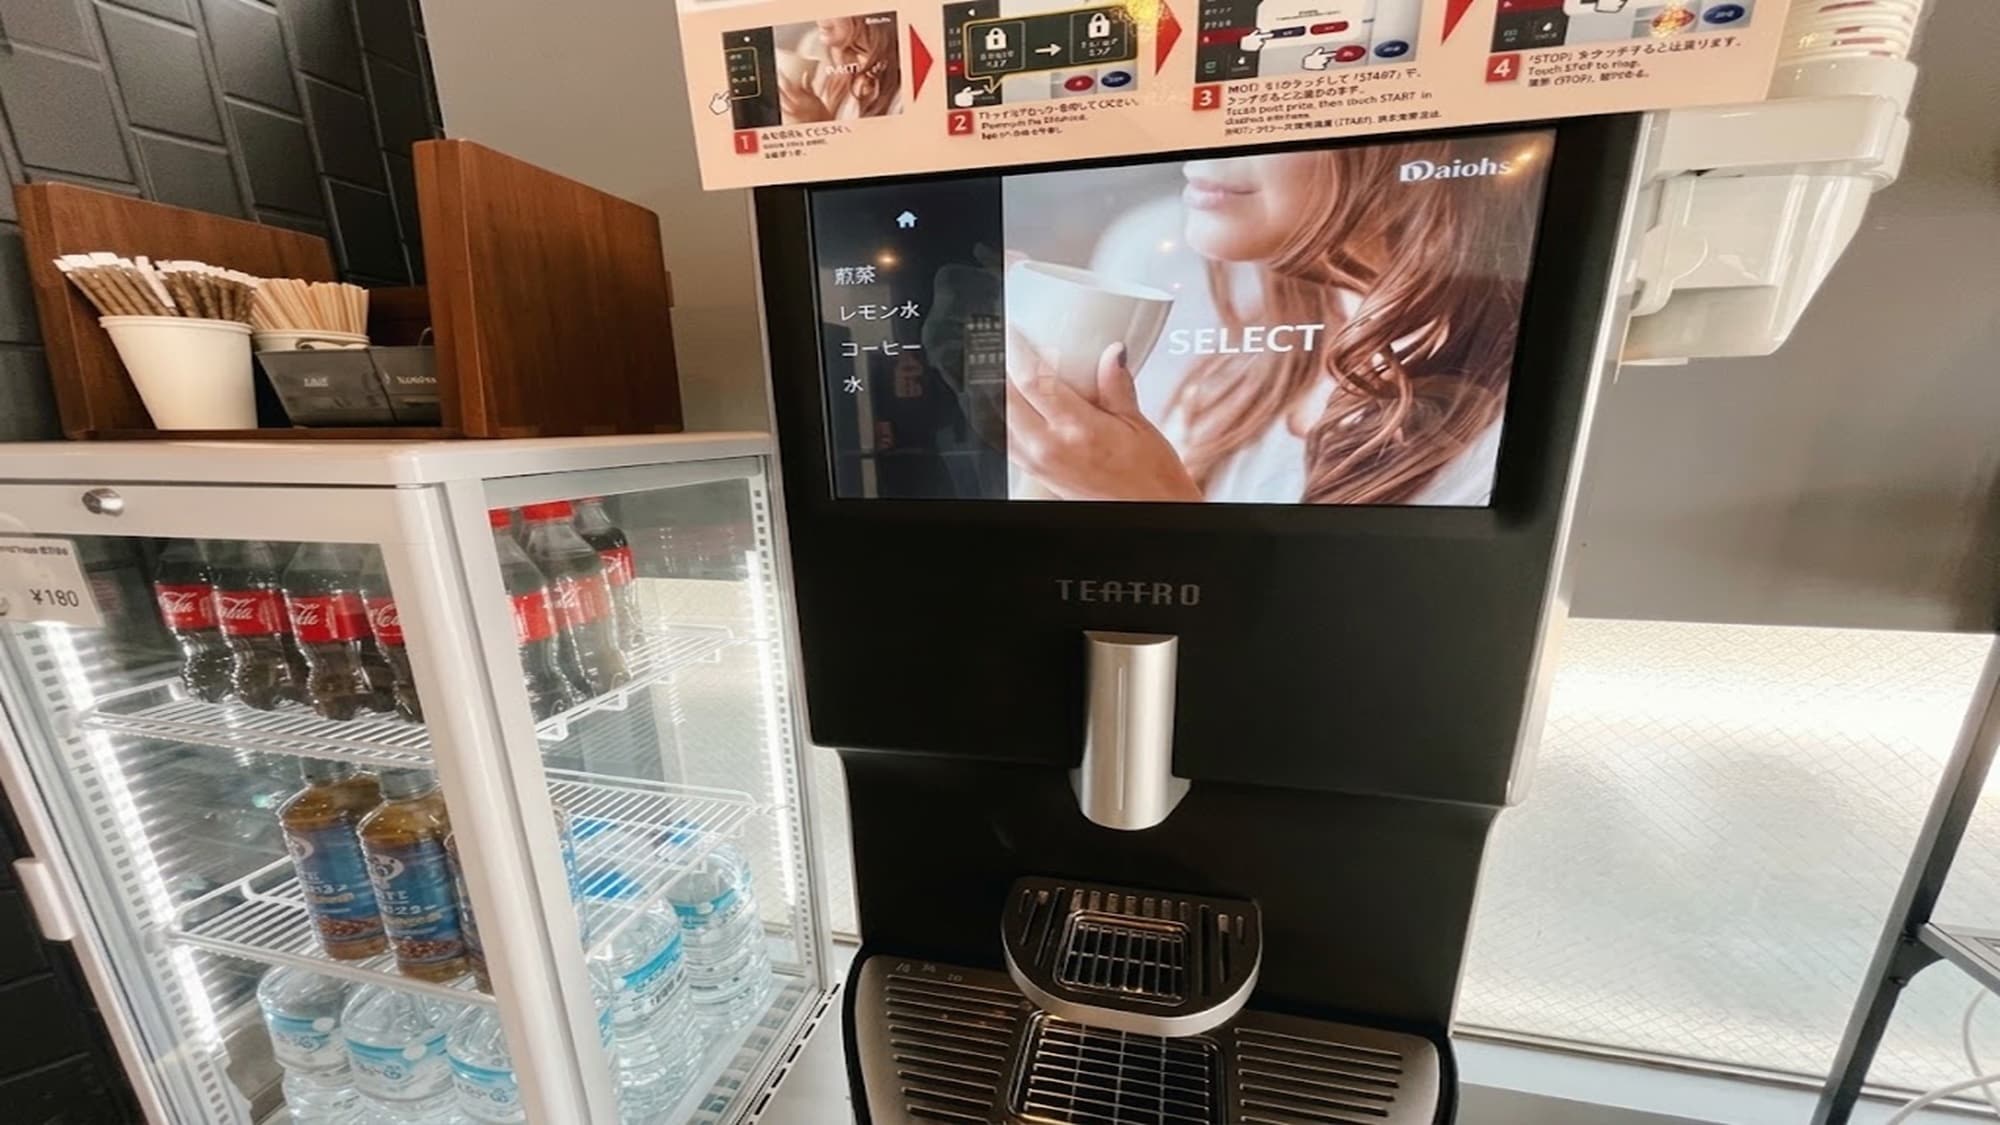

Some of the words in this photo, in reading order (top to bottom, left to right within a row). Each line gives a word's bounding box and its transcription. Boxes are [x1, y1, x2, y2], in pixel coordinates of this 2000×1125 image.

[1493, 58, 1512, 77] 4
[1200, 89, 1213, 106] 3
[954, 115, 968, 132] 2
[740, 135, 750, 150] 1
[1400, 157, 1512, 182] Daiohs
[834, 265, 877, 285] 煎茶
[840, 300, 921, 321] レモン水
[841, 341, 922, 357] コーヒー
[1168, 324, 1325, 355] SELECT
[843, 376, 864, 393] 水
[29, 588, 79, 607] ¥180
[1055, 579, 1201, 606] TEATRO
